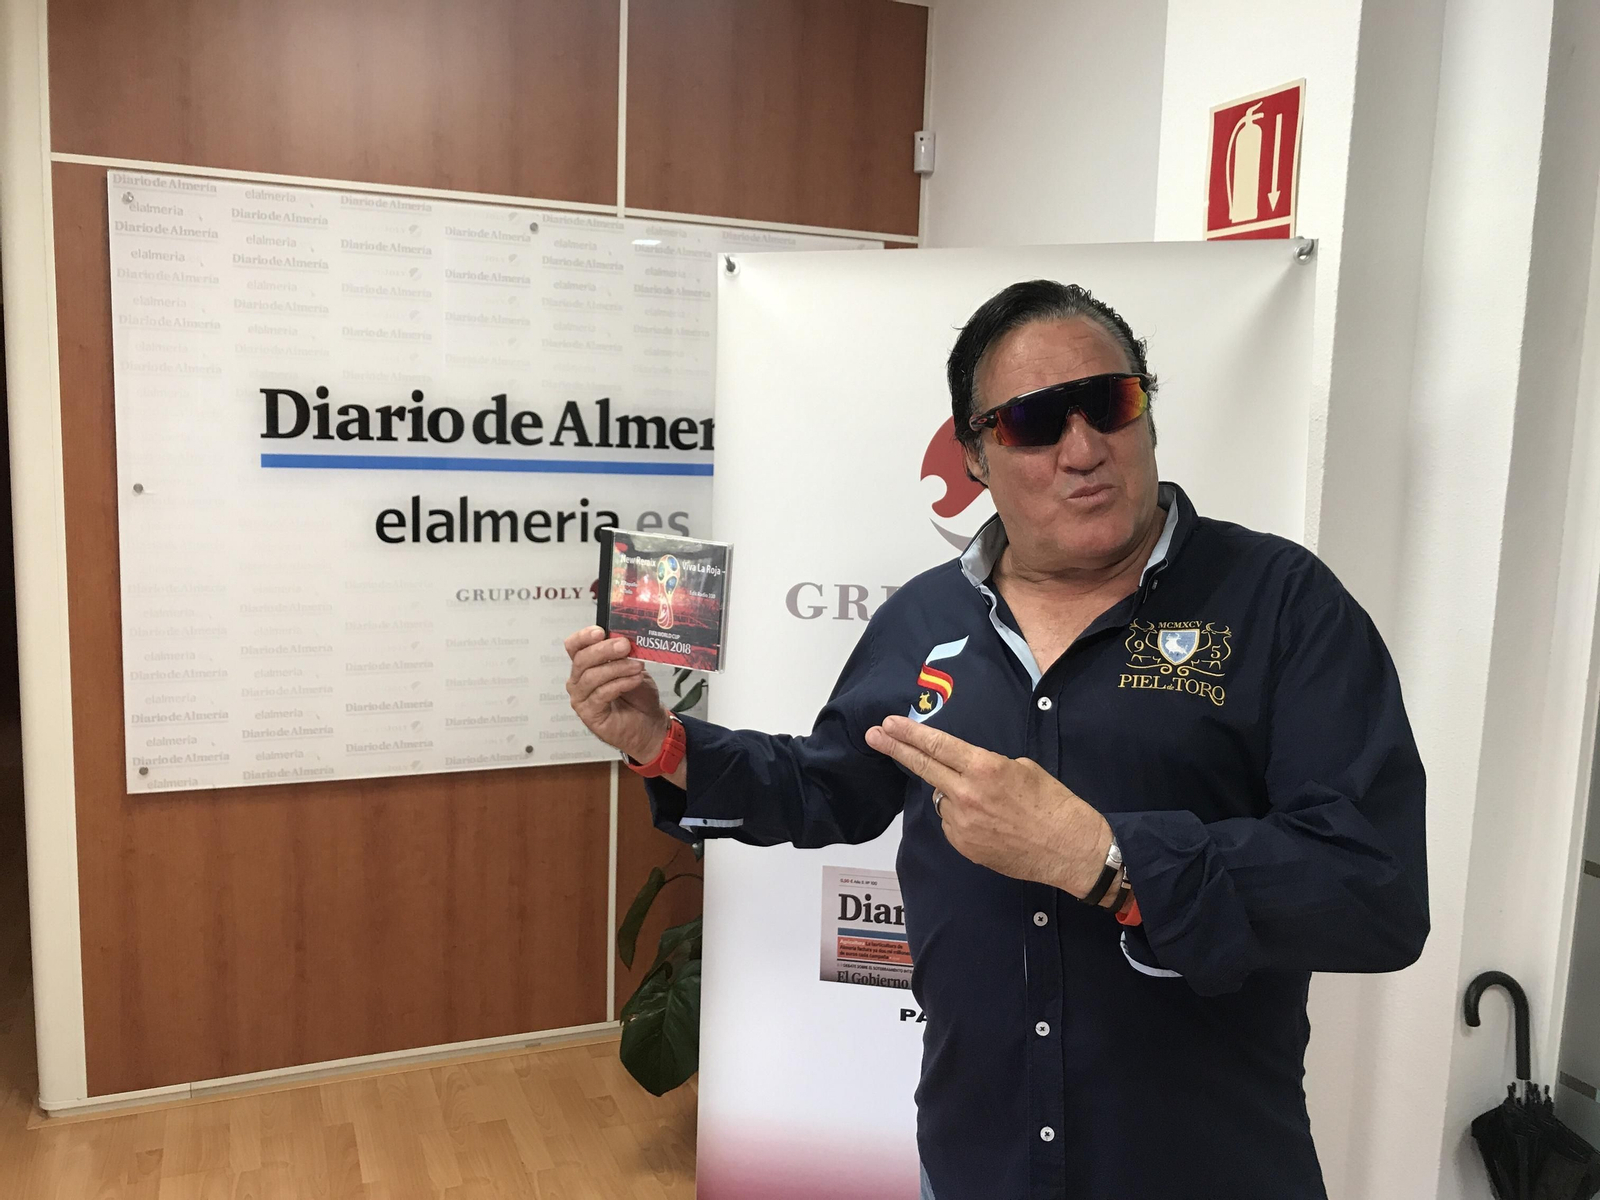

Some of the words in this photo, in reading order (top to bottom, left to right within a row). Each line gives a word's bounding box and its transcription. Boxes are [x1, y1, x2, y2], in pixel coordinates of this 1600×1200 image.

[260, 386, 464, 442] Diario
[472, 394, 543, 445] de
[550, 398, 714, 450] Almer
[682, 560, 696, 571] Viva
[697, 563, 705, 573] La
[706, 564, 721, 576] Roja
[456, 586, 584, 602] GRUPOJOLY
[786, 581, 901, 621] GR
[1158, 620, 1202, 629] MCMXCV
[636, 636, 669, 650] RUSSIA
[670, 641, 691, 654] 2018
[1134, 640, 1144, 652] 9
[1210, 645, 1221, 658] 5
[1118, 674, 1166, 689] PIEL
[1172, 677, 1225, 706] TORO
[837, 970, 848, 983] El
[852, 972, 909, 988] Gobierno
